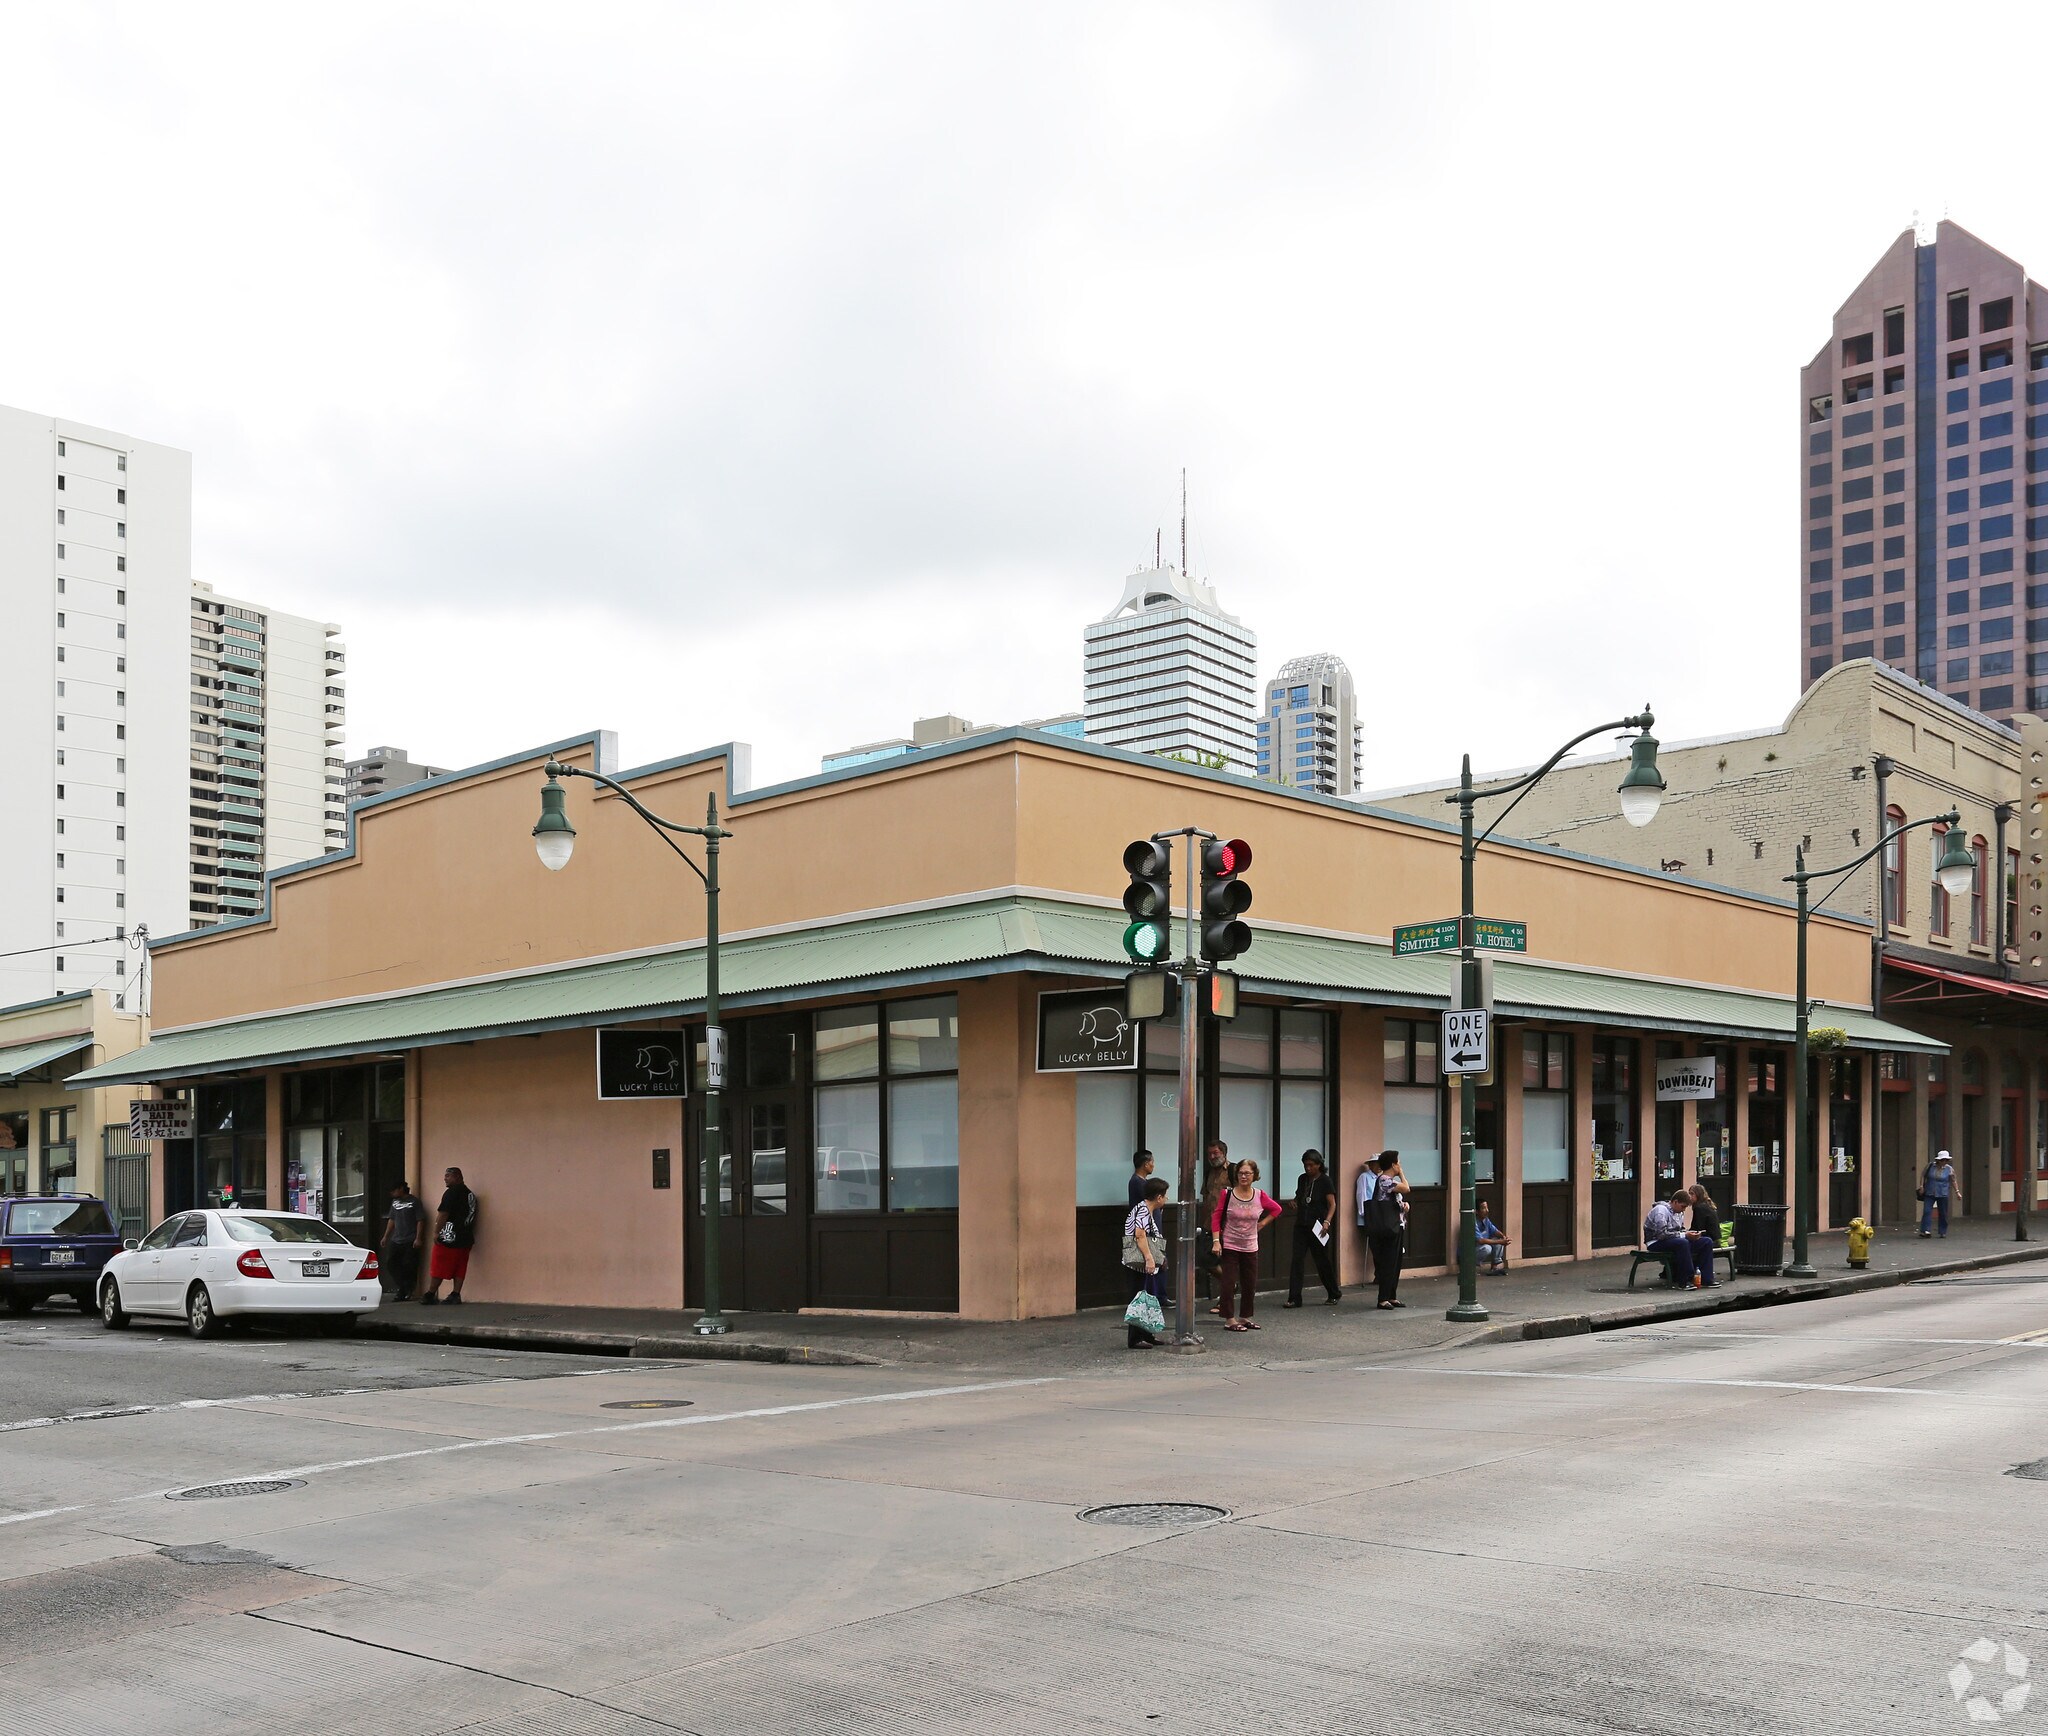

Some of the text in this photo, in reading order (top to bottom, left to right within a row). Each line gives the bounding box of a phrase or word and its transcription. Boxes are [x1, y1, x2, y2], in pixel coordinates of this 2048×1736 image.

[1441, 925, 1456, 933] 1100
[1399, 937, 1440, 952] SMITH
[1475, 933, 1524, 948] N. HOTEL ST
[1449, 1015, 1483, 1031] ONE
[1449, 1032, 1483, 1048] WAY
[1059, 1050, 1128, 1063] LUCKY BELLY
[619, 1082, 680, 1092] LUCKY BELLY
[1657, 1074, 1715, 1092] DOWNBEAT
[142, 1103, 188, 1112] RAINBOW
[149, 1111, 174, 1120] HAIR
[141, 1120, 188, 1128] STYLING
